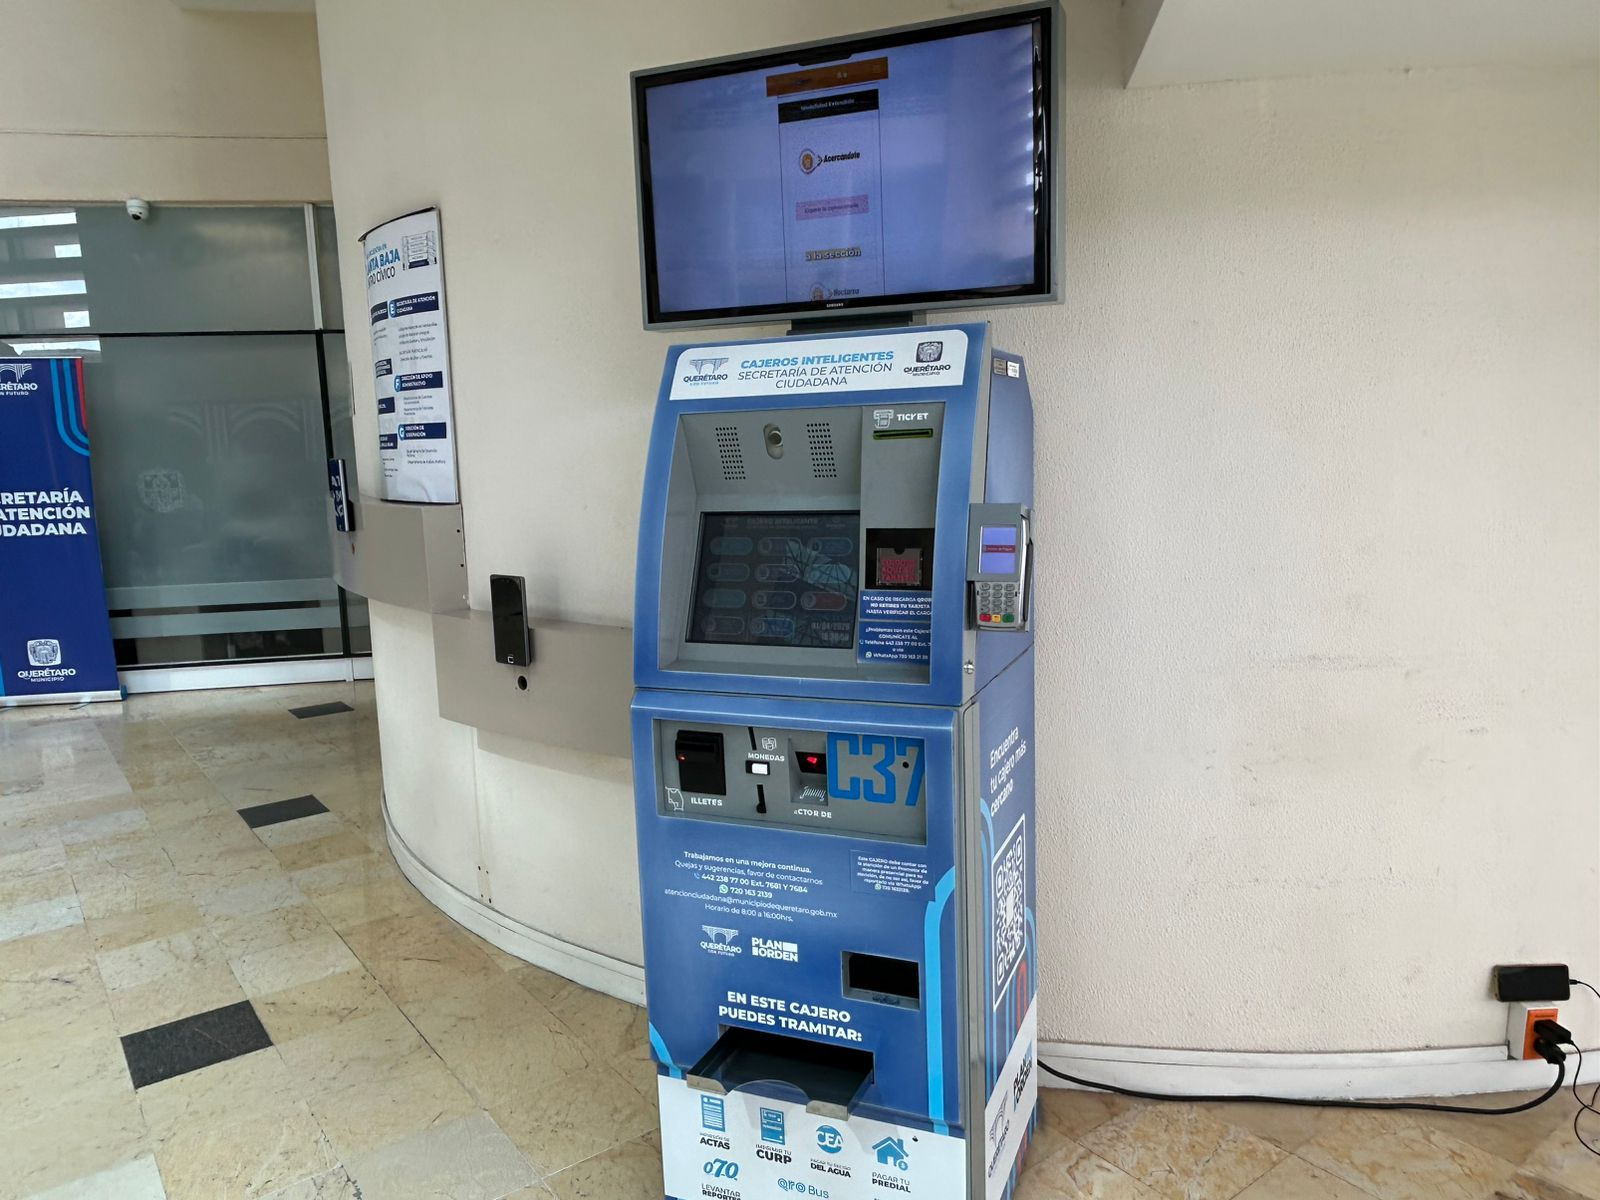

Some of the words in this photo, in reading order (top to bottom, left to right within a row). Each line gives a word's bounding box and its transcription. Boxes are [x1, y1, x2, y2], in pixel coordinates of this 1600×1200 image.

[380, 248, 400, 268] BAJA
[741, 357, 798, 369] CAJEROS
[802, 351, 894, 365] INTELIGENTES
[738, 366, 807, 380] SECRETARÍA
[810, 367, 828, 376] DE
[830, 362, 893, 375] ATENCIÓN
[904, 364, 951, 374] QUERÉTARO
[683, 374, 728, 382] QUERÉTARO
[776, 377, 847, 389] CIUDADANA
[0, 382, 38, 390] RÉTARO
[0, 487, 84, 504] RETARÍA
[0, 522, 87, 537] DADANA
[18, 668, 76, 680] QUERÉTARO
[990, 726, 1018, 769] Encuentra
[748, 752, 785, 761] MONEDAS
[826, 732, 925, 806] C37
[990, 775, 997, 794] tu
[998, 755, 1014, 784] cajero
[1015, 739, 1026, 763] más
[991, 778, 1013, 817] cercano
[684, 851, 724, 862] Trabajamos
[750, 860, 776, 869] mejora
[777, 863, 812, 874] continua.
[674, 860, 698, 869] Quejas
[704, 865, 746, 876] sugerencias,
[776, 874, 823, 885] contactarnos
[704, 904, 729, 912] Horario
[700, 941, 742, 953] QUERÉTARO
[752, 937, 782, 950] PLAN
[759, 948, 798, 962] ORDEN
[728, 991, 746, 1004] EN
[751, 995, 786, 1011] ESTE
[790, 1002, 850, 1022] CAJERO
[719, 1006, 775, 1026] PUEDES
[779, 1016, 863, 1042] TRAMITAR:
[700, 1137, 730, 1150] ACTAS
[817, 1130, 843, 1148] CEA
[756, 1149, 792, 1164] CURP
[810, 1163, 826, 1172] DEL
[828, 1167, 851, 1178] AGUA
[872, 1172, 898, 1183] PAGAR
[702, 1184, 740, 1197] LEVANTAR
[809, 1185, 829, 1199] Bus
[872, 1178, 911, 1193] PREDIAL
